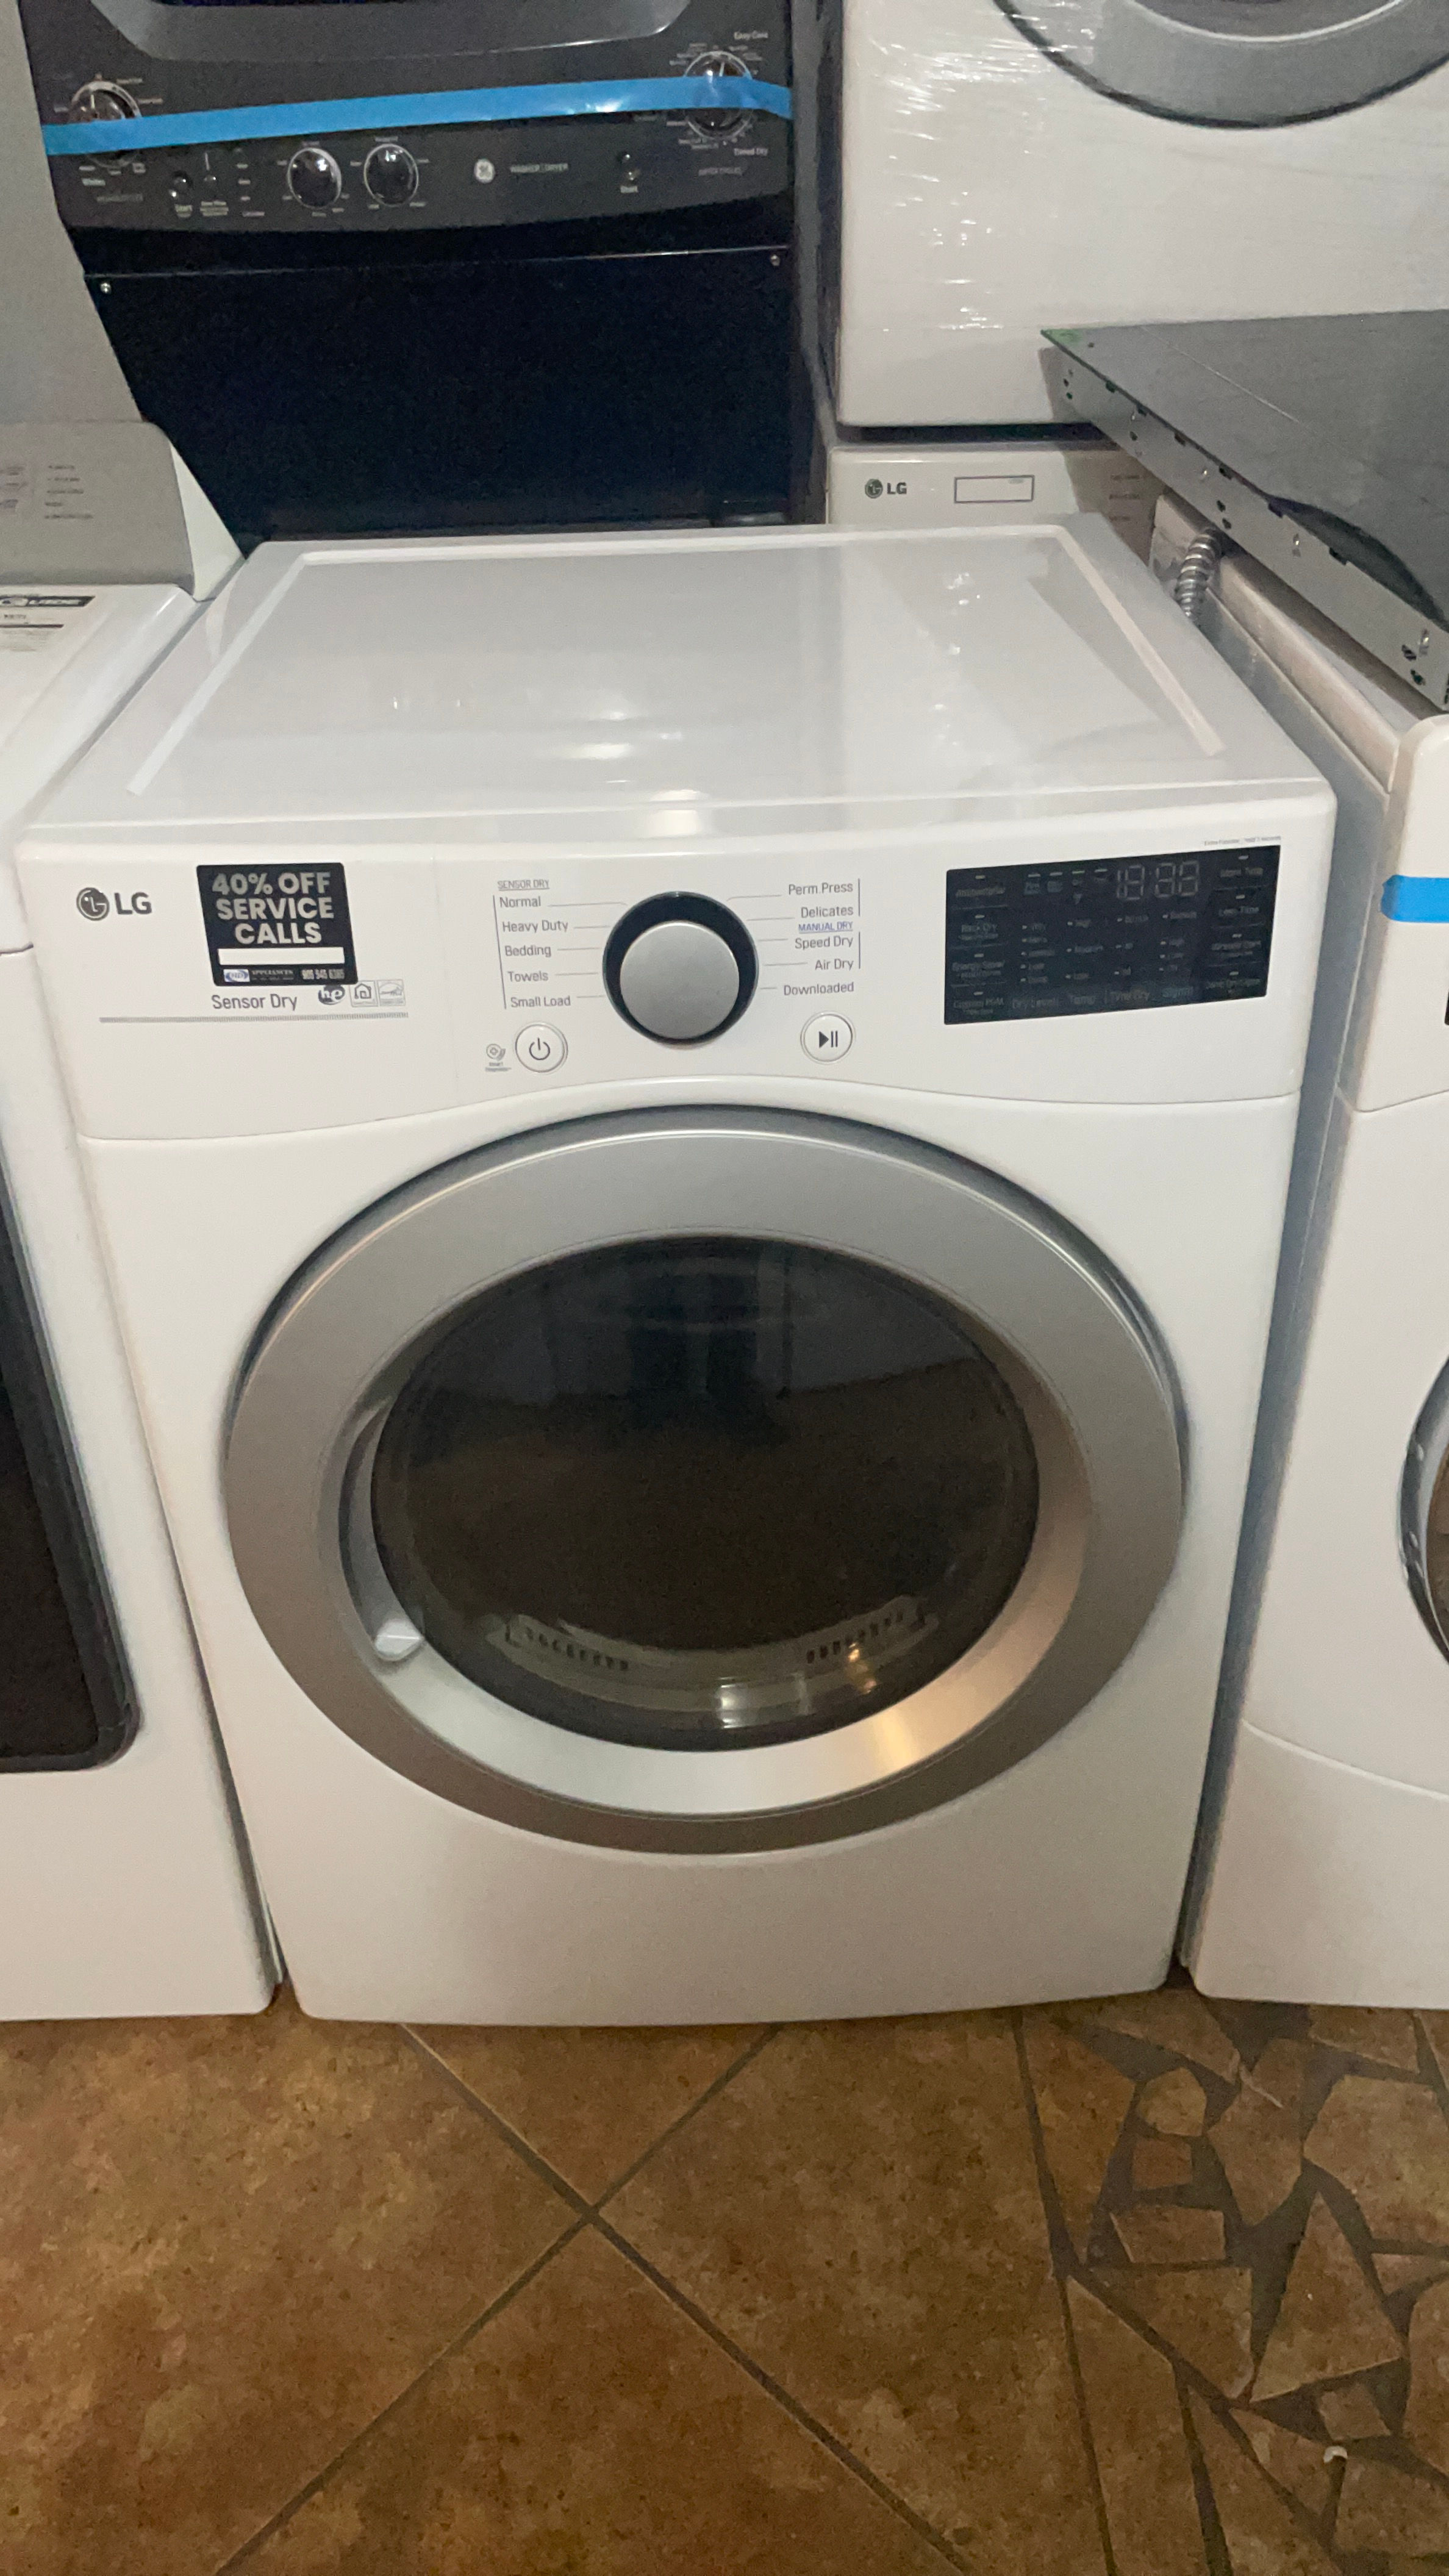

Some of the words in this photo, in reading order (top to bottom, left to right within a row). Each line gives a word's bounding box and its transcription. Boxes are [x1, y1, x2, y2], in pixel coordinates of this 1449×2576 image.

[887, 482, 907, 495] LG
[212, 872, 273, 895] 40%
[278, 871, 331, 894] OFF
[497, 879, 531, 889] SENSOR
[533, 879, 549, 888] DRY
[821, 882, 853, 893] Press
[114, 892, 152, 915] LG
[216, 896, 334, 920] SERVICE
[499, 895, 542, 908] Normal
[801, 906, 854, 918] Delicates
[234, 921, 322, 945] CALLS
[503, 921, 538, 934] Heavy
[542, 919, 568, 932] Duty
[798, 922, 835, 932] MANUAL
[837, 921, 854, 931] DRY
[795, 936, 831, 950] Speed
[833, 935, 854, 948] Dry
[504, 945, 552, 958] Bedding
[815, 959, 831, 971] Air
[834, 958, 854, 971] Dry
[507, 970, 549, 982] Towels
[784, 981, 854, 996] Downloaded
[212, 995, 265, 1009] Sensor
[270, 993, 298, 1011] Dry
[510, 996, 541, 1007] Small
[543, 995, 571, 1007] Load
